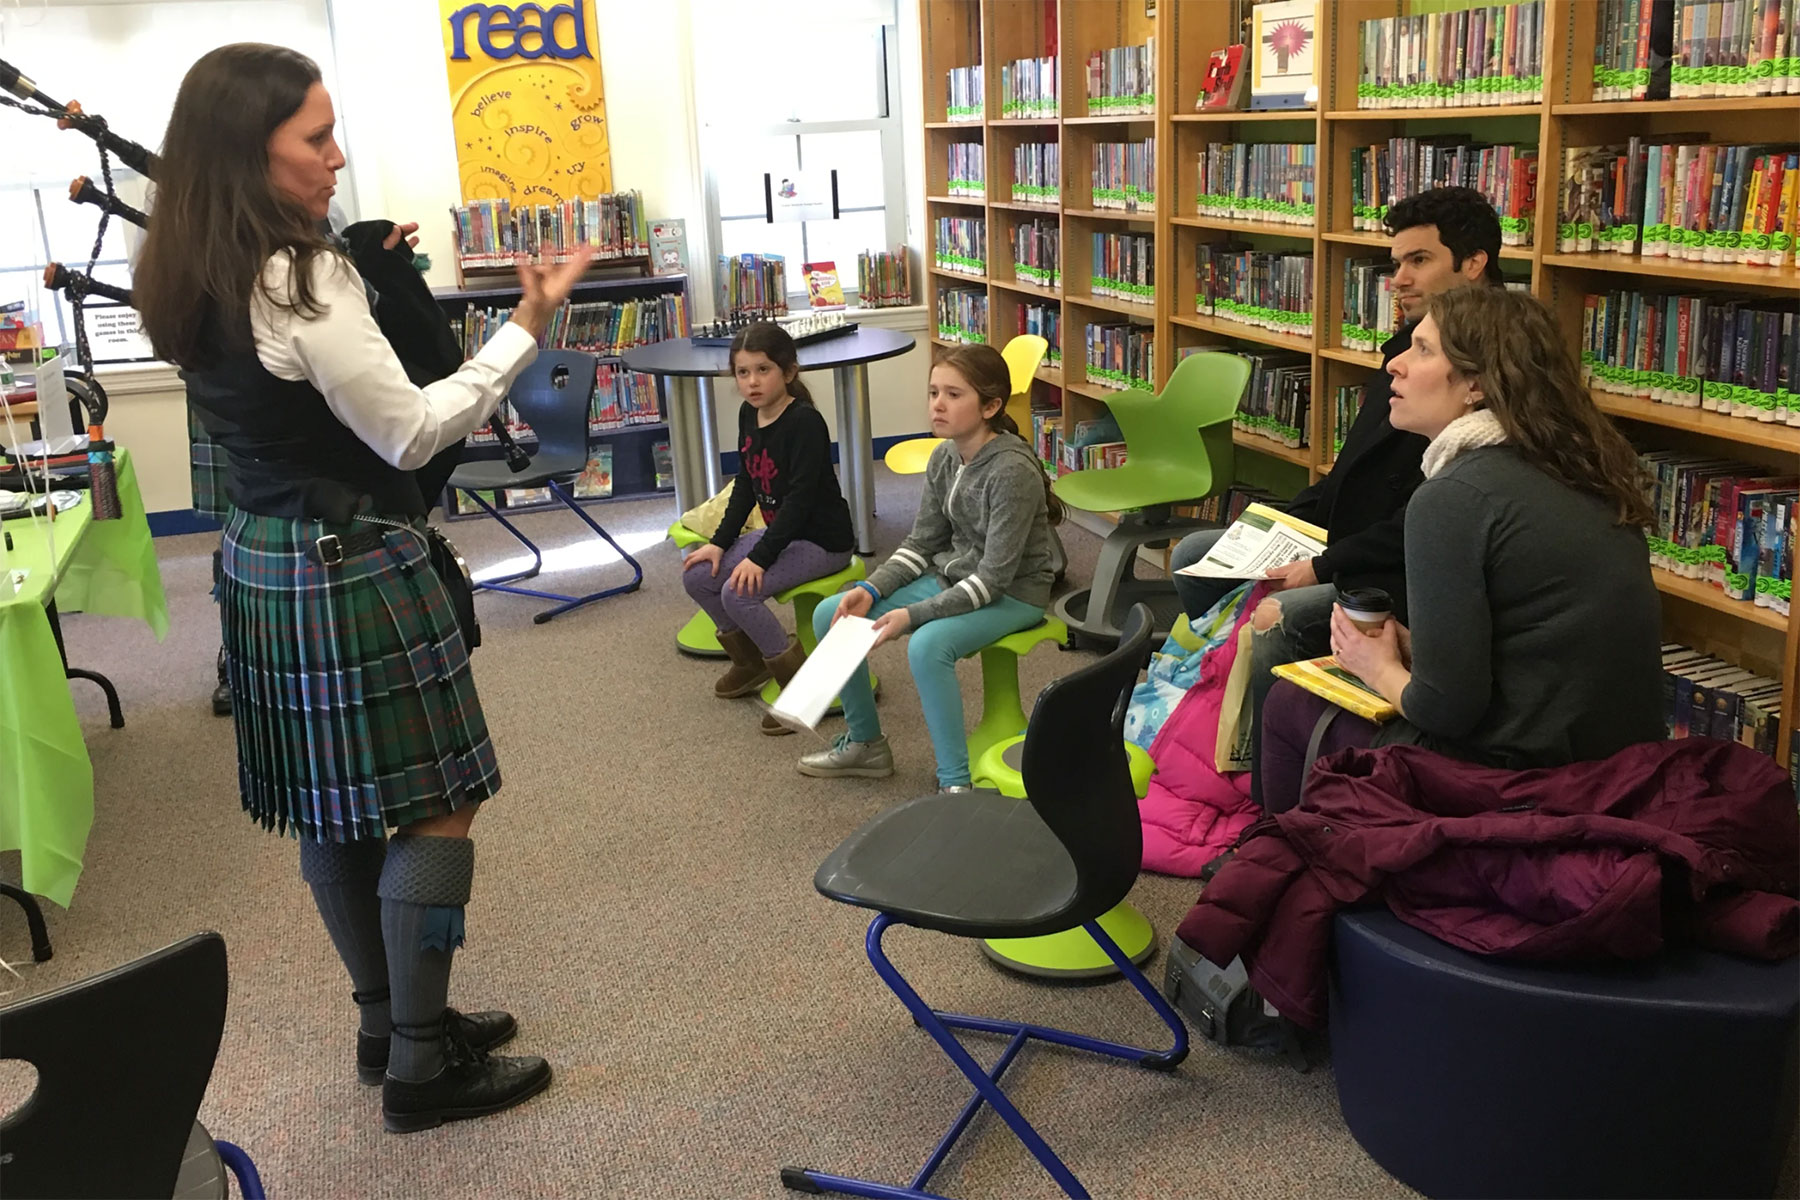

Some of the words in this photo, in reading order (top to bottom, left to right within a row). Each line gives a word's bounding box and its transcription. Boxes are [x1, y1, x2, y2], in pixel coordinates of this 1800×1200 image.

[448, 0, 594, 60] read
[471, 90, 512, 117] believe
[570, 114, 604, 131] grow
[504, 124, 552, 144] inspire
[566, 161, 586, 175] try
[480, 166, 516, 194] imagine
[523, 184, 564, 204] dream
[0, 333, 16, 344] AN
[1679, 314, 1687, 352] DOUBLE
